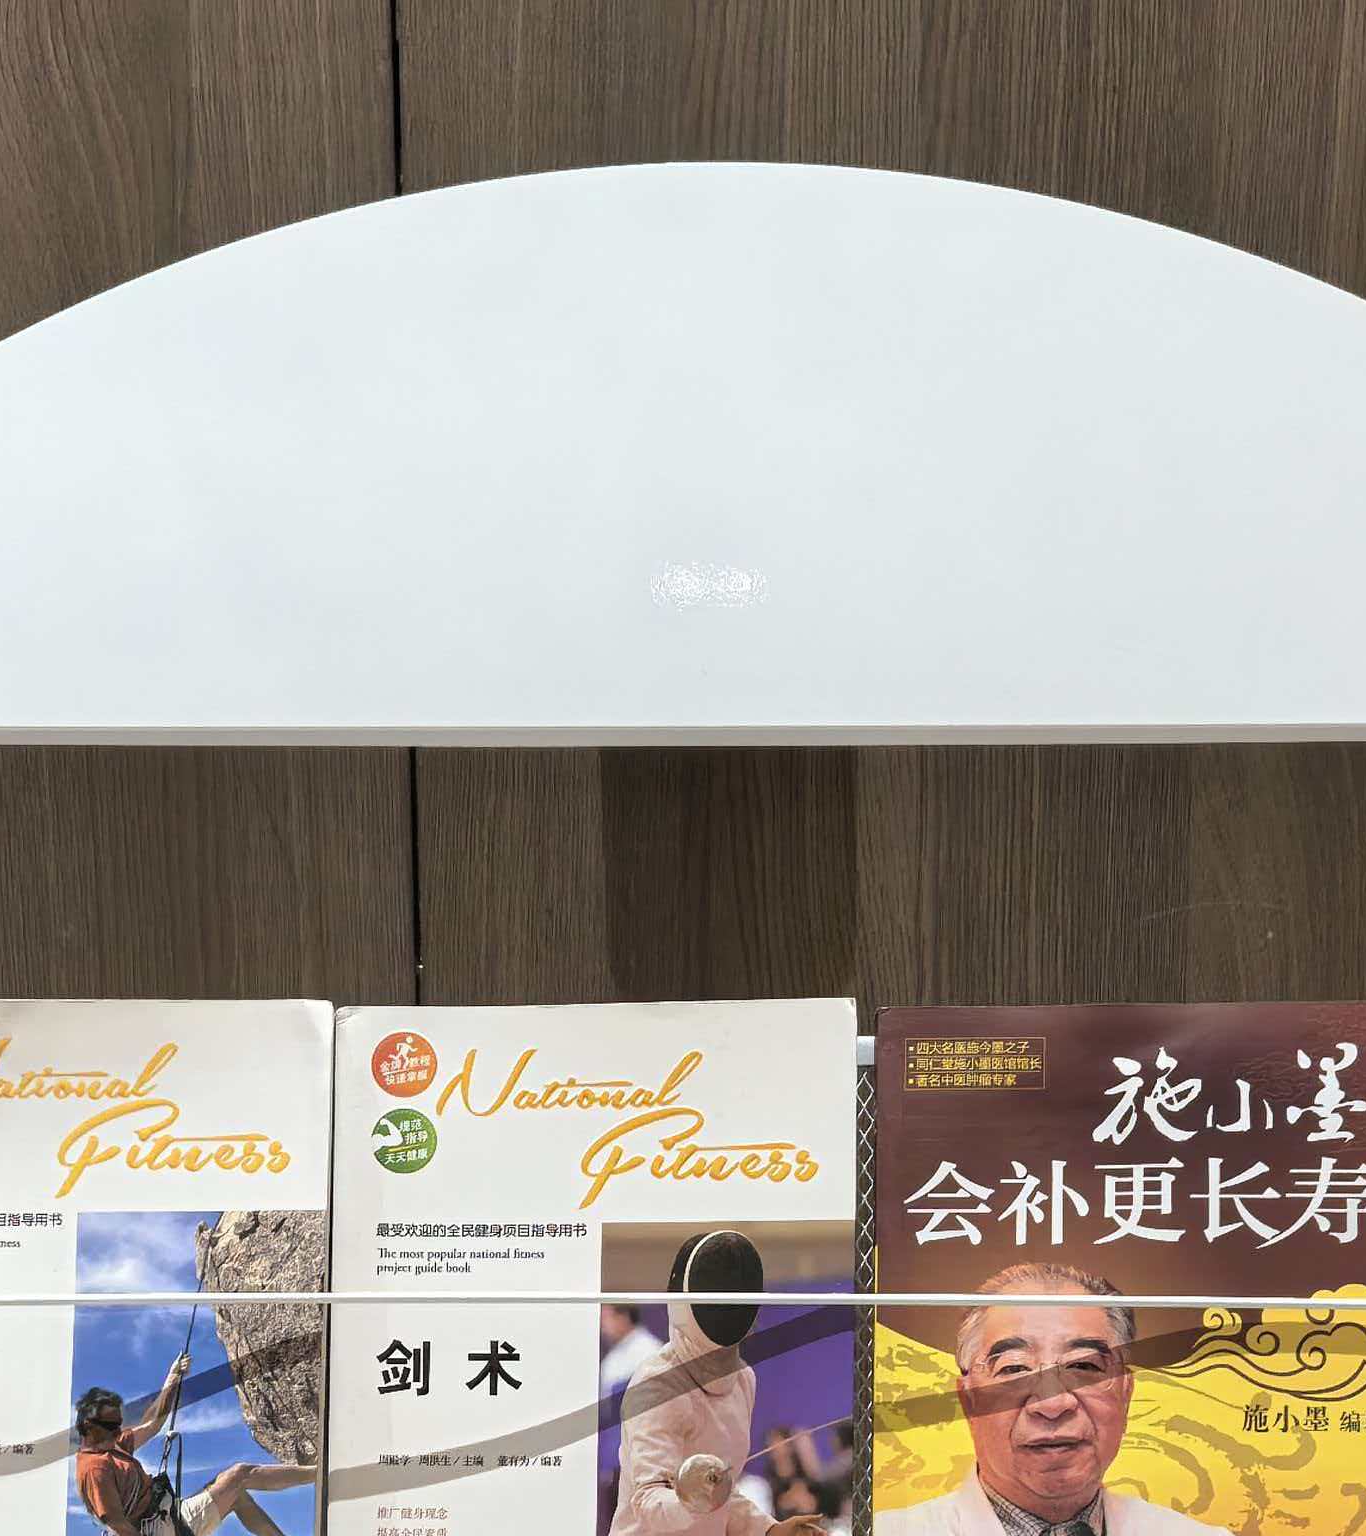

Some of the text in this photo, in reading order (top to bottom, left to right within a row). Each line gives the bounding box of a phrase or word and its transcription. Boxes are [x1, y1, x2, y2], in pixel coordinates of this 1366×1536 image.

[435, 1048, 704, 1118] National
[56, 1098, 292, 1200] Fitness
[578, 1107, 820, 1210] Fitness
[376, 1222, 588, 1238] 最受欢迎的全民健身项目指导用书
[376, 1262, 471, 1276] project guide book
[378, 1247, 545, 1262] The most popular national fitness
[375, 1339, 523, 1397] 剑术
[1242, 1404, 1330, 1433] 施小墨
